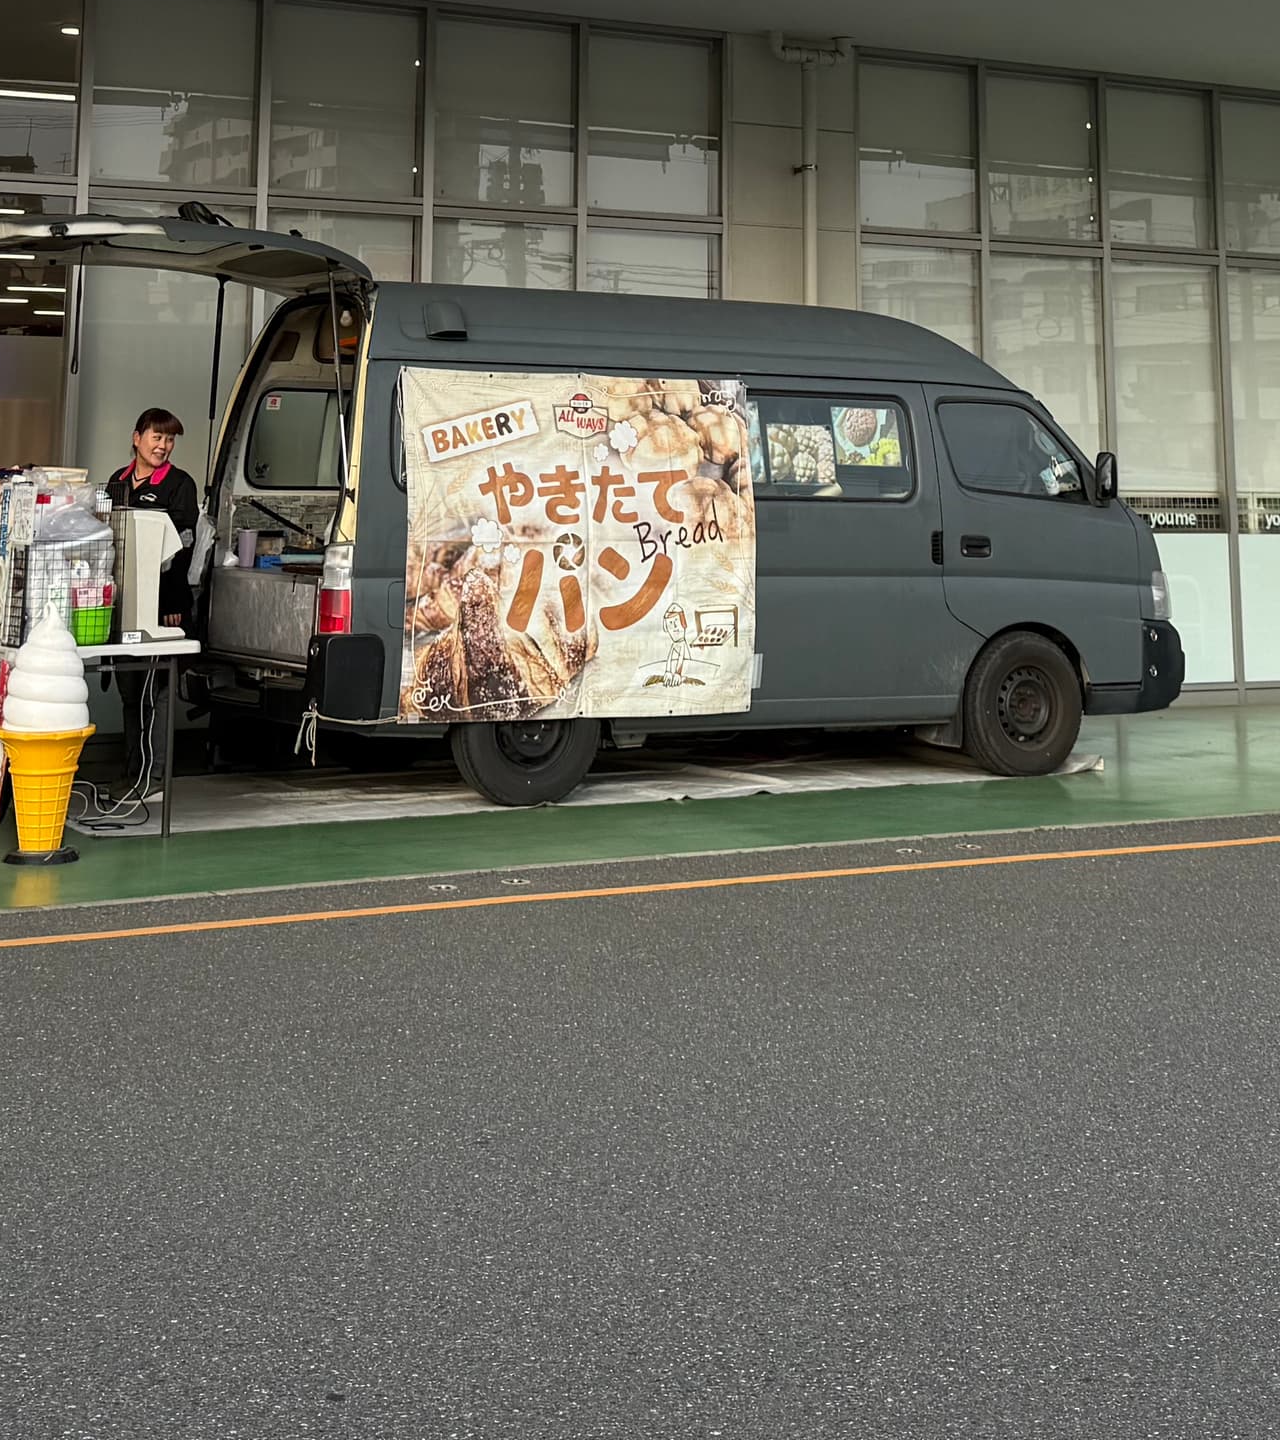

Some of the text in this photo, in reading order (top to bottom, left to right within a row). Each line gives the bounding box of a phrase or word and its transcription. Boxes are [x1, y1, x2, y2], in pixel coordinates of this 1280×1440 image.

[431, 407, 526, 454] BAKERY
[558, 410, 575, 423] ALL
[576, 418, 605, 432] WAYS
[478, 461, 689, 525] やきたて
[633, 503, 723, 563] Bread
[506, 533, 673, 633] パン
